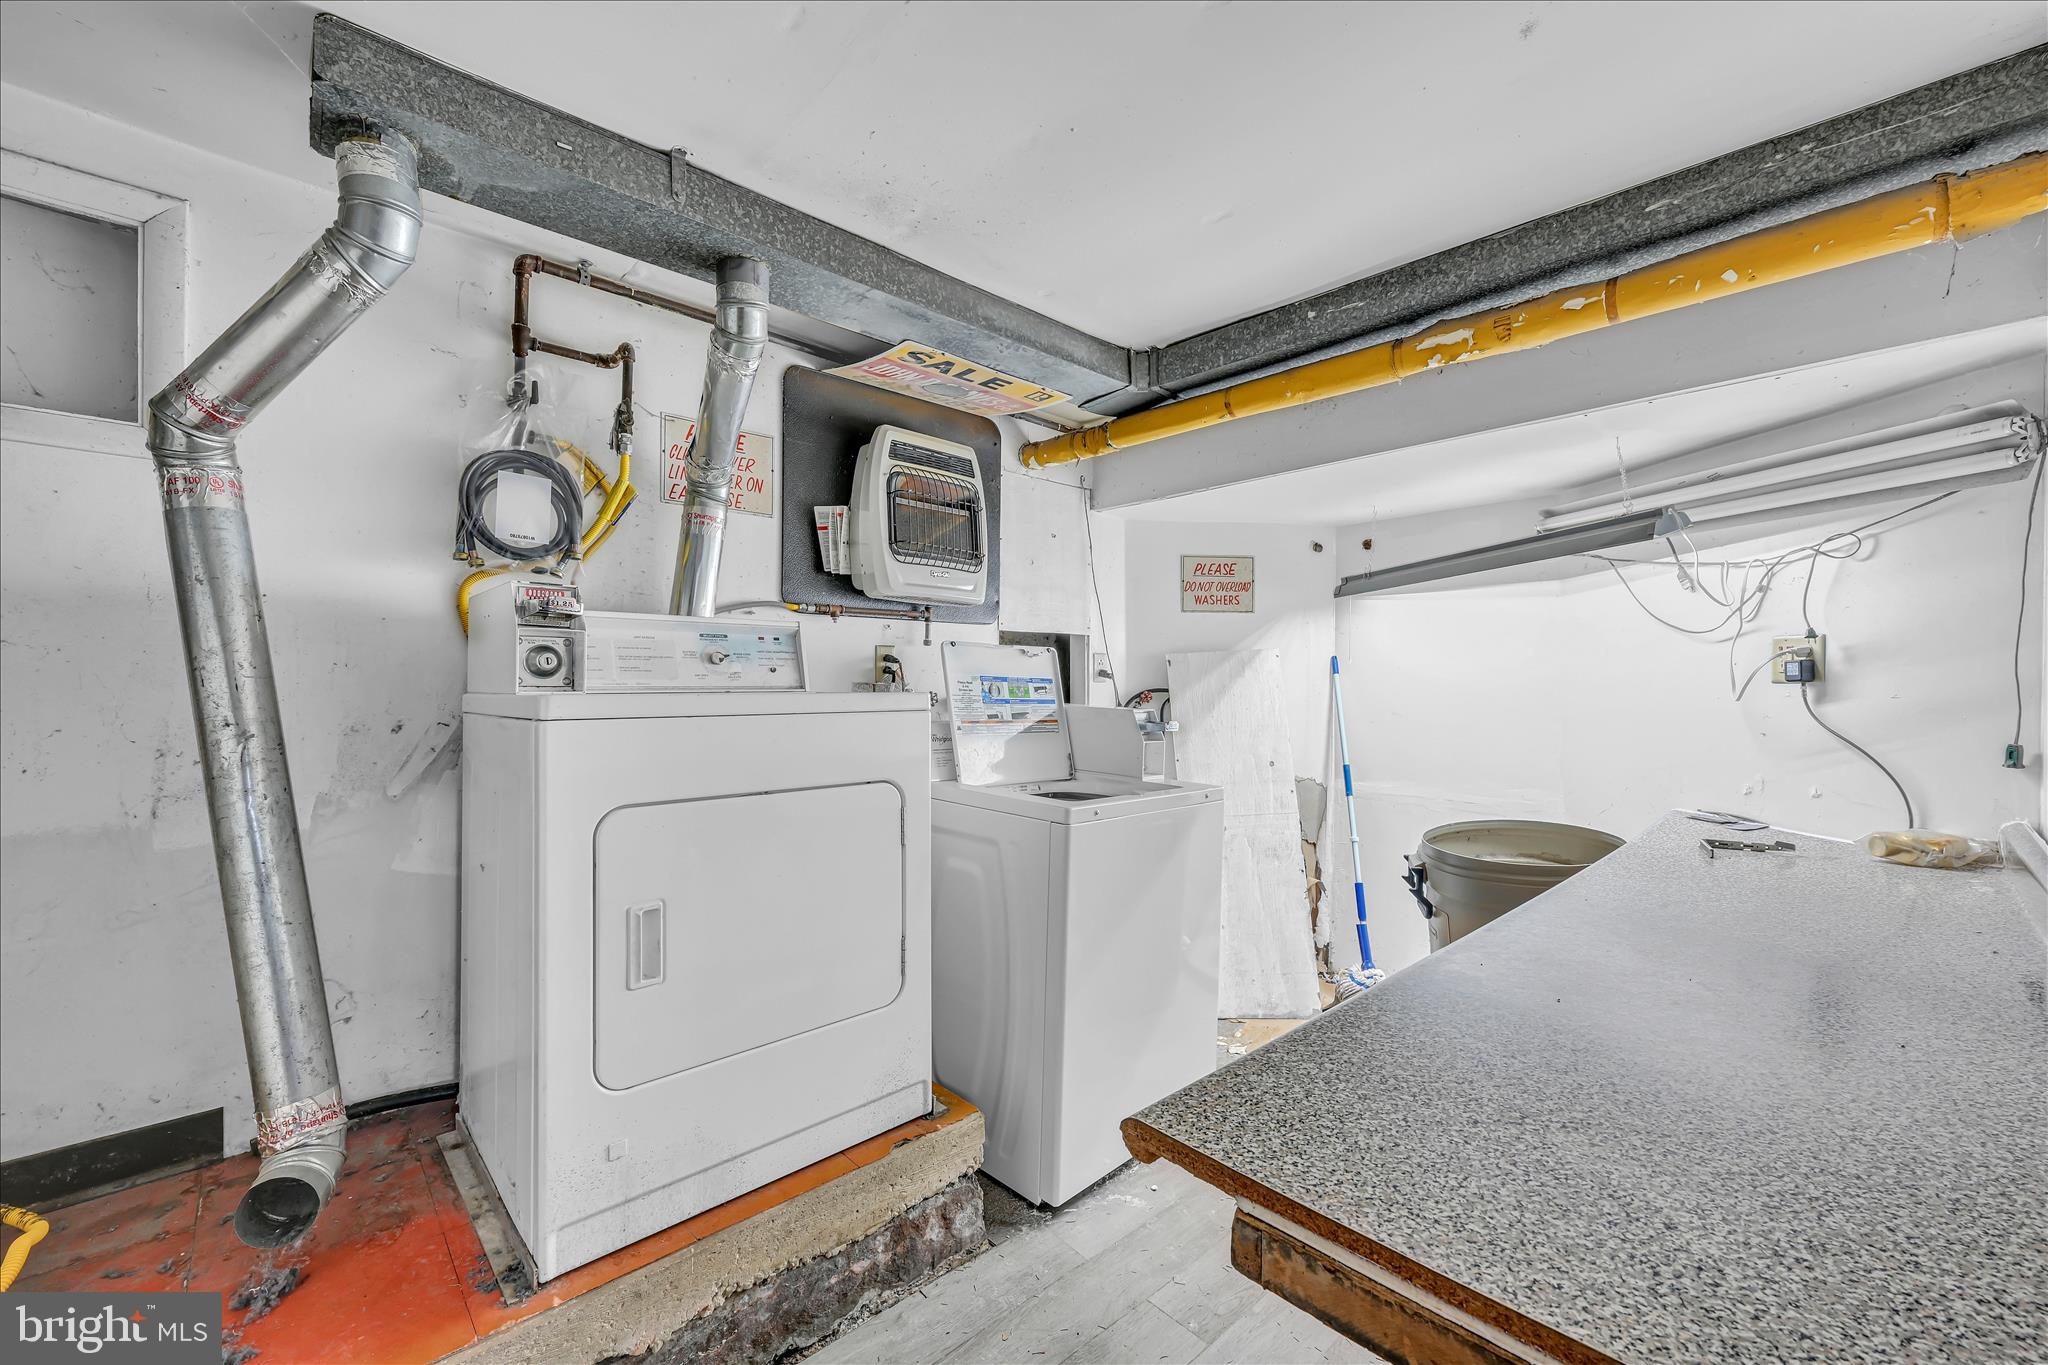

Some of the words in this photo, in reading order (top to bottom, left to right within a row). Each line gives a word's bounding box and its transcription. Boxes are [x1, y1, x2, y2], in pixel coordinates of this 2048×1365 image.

[862, 364, 926, 381] JOHN
[897, 350, 1014, 392] SALE
[746, 476, 764, 494] ON
[1194, 563, 1237, 576] PLEASE
[1184, 581, 1197, 593] DO
[1197, 581, 1215, 592] NOT
[1215, 581, 1252, 593] OVERLOAD
[1194, 594, 1240, 606] WASHERS
